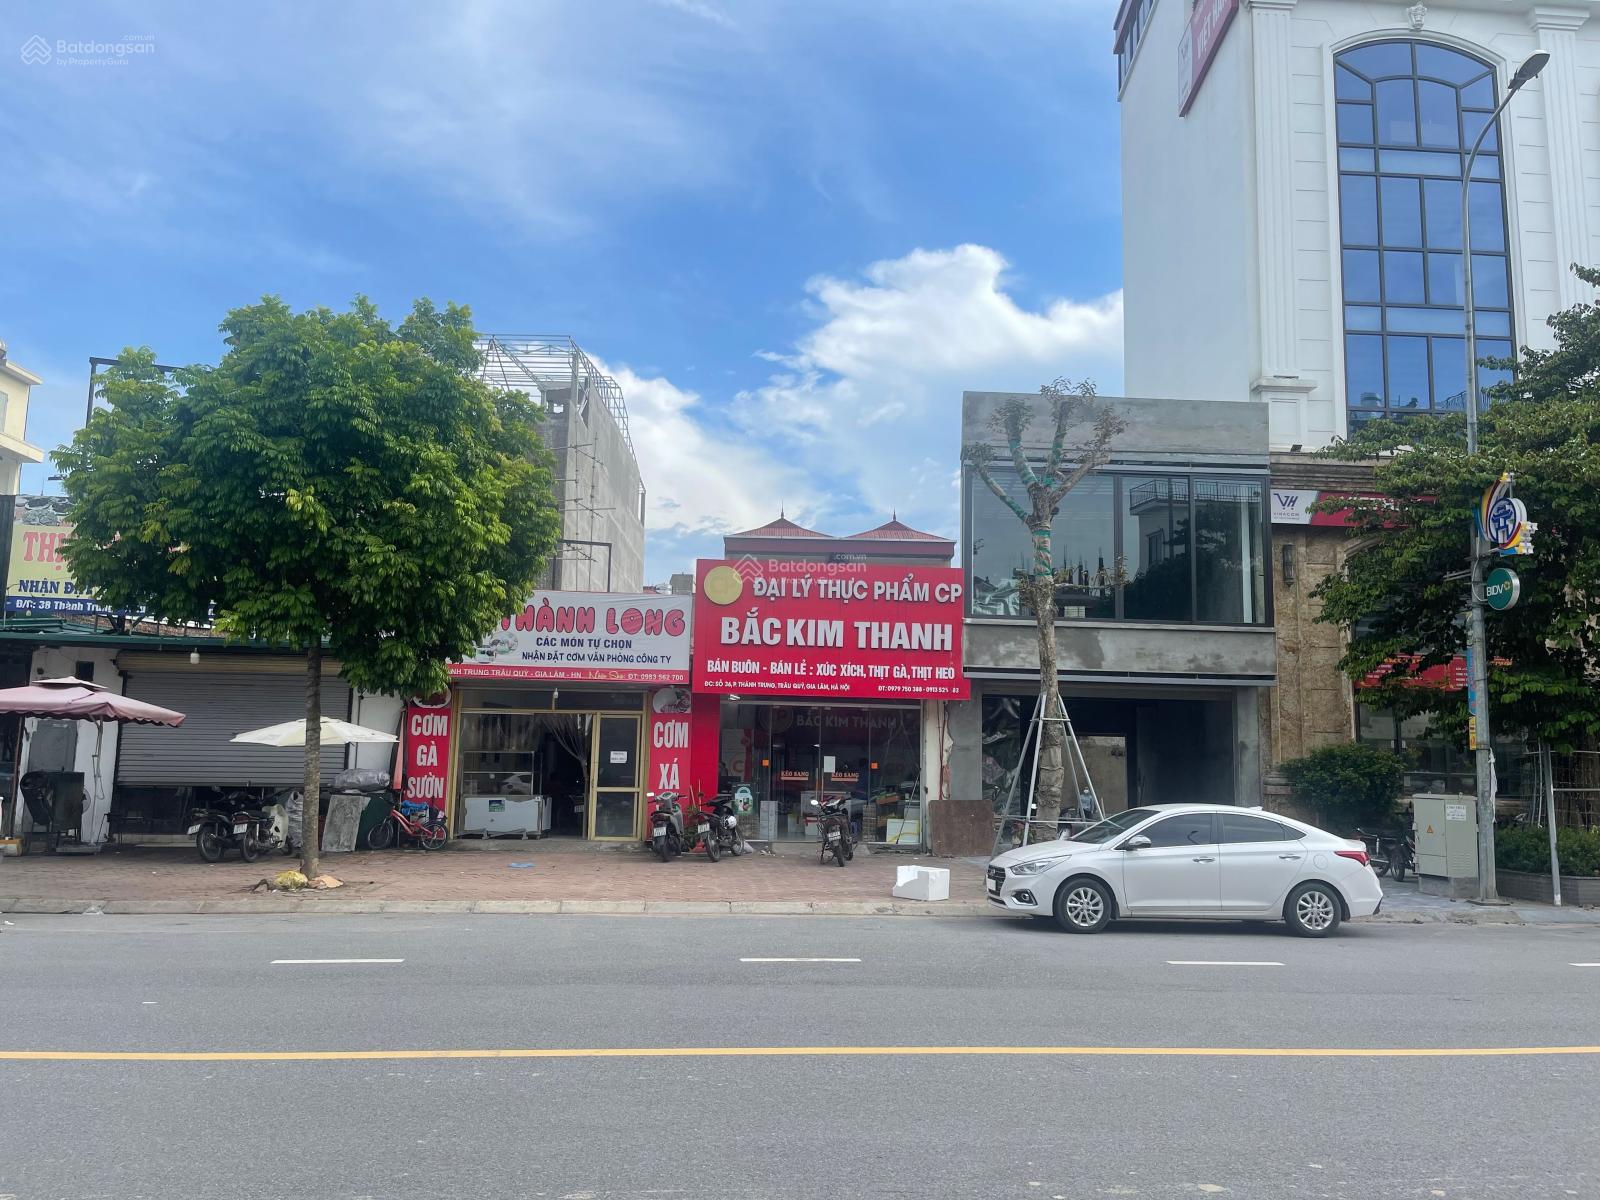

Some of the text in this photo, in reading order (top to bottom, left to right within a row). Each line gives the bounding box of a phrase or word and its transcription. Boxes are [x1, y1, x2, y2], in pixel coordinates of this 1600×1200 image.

[23, 531, 78, 571] THỊ
[18, 577, 61, 597] NHẬN
[752, 572, 962, 604] ĐẠI LÝ THỰC PHẨM CP
[1486, 583, 1504, 597] BIDV
[38, 600, 52, 610] 38
[53, 600, 84, 612] Thành
[605, 607, 686, 637] LONG
[720, 607, 953, 651] BẮC KIM THANH
[535, 635, 632, 651] CÁC MÓN TỰ CHỌN
[522, 651, 672, 665] NHẬN ĐẶT CƠM VĂN PHÒNG CÔNG TY
[707, 657, 730, 673] BÁN
[731, 658, 760, 674] BUÔN
[770, 659, 792, 675] BÁN
[793, 659, 807, 676] LẺ
[815, 661, 837, 677] XÚC
[839, 661, 867, 679] XÍCH,
[868, 664, 890, 680] THỊT
[892, 663, 911, 680] GÀ,
[911, 666, 933, 681] THỊT
[935, 666, 956, 679] HEO
[464, 668, 490, 676] TRUNG
[491, 669, 511, 677] TRÂU
[549, 669, 565, 678] LÂM
[830, 682, 839, 691] HÀ
[839, 682, 850, 692] NỘI
[411, 713, 448, 737] CƠM
[653, 719, 689, 749] CƠM
[825, 714, 849, 728] KIM
[852, 715, 897, 730] THANH
[416, 740, 438, 767] GÀ
[407, 771, 445, 799] SƯỜN
[658, 757, 680, 790] XÁ
